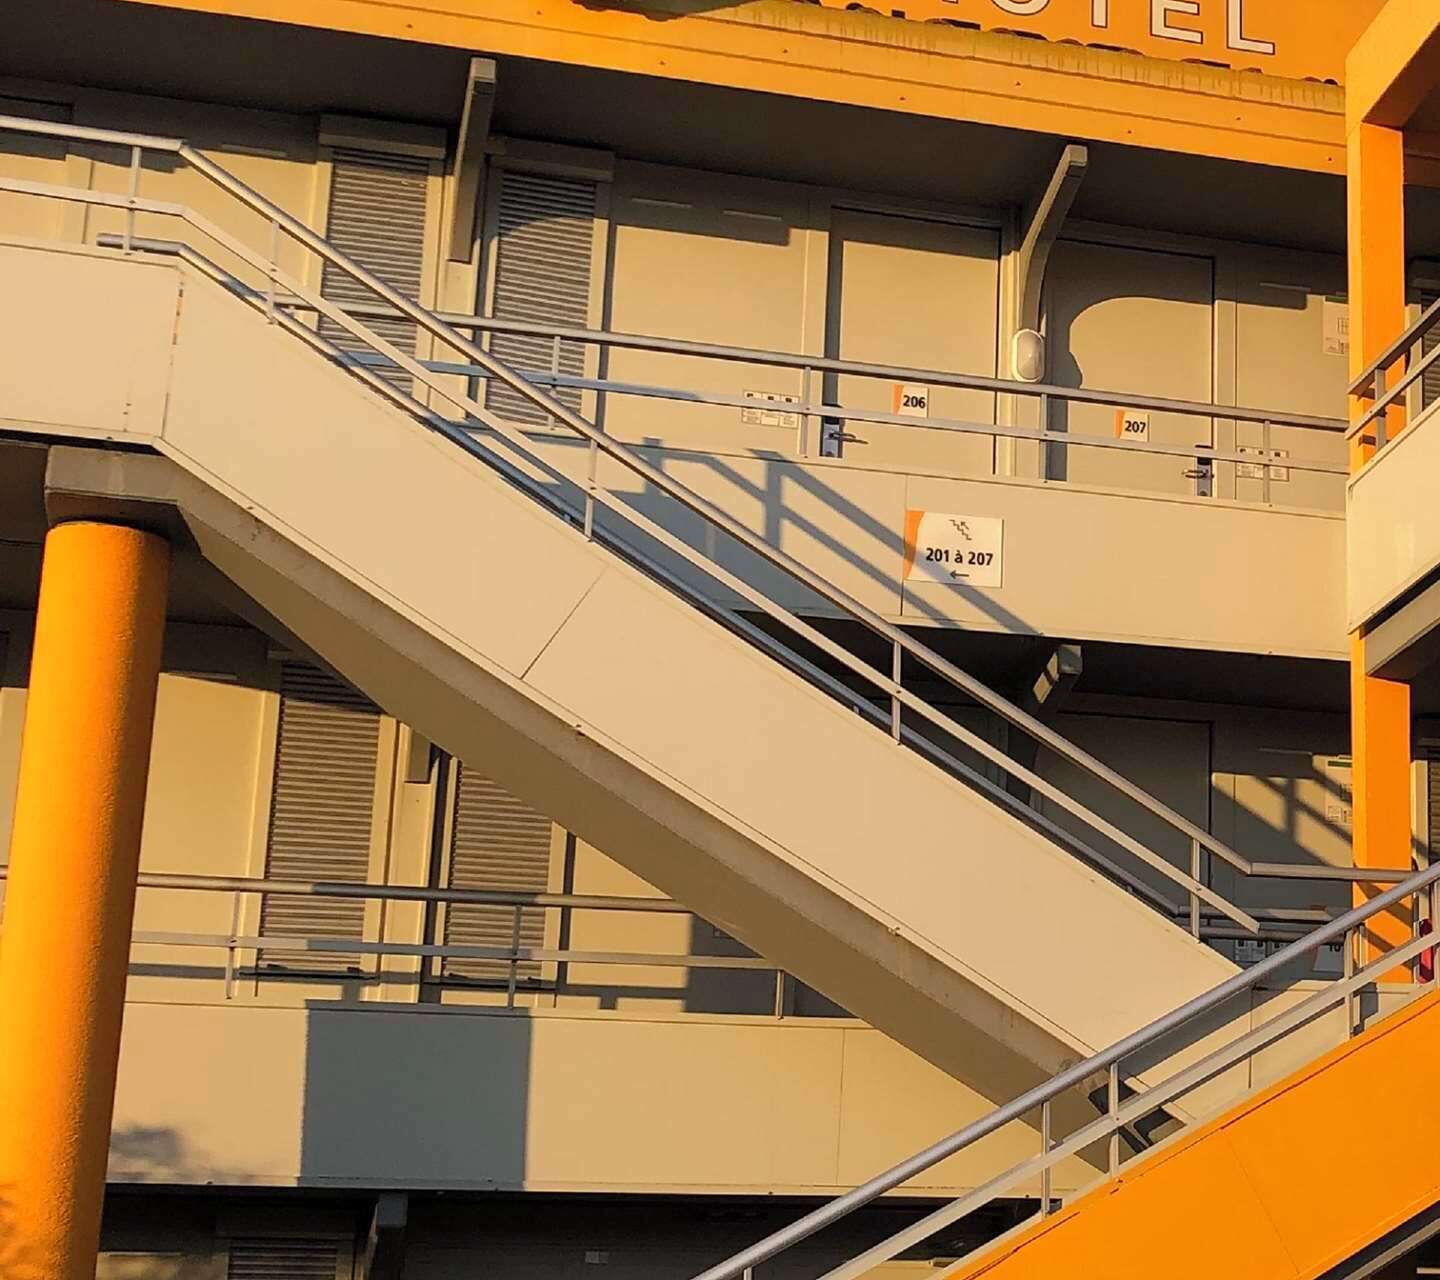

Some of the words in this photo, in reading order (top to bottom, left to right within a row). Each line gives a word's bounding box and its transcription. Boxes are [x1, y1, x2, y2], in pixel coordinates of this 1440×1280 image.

[903, 394, 926, 409] 206
[1125, 420, 1147, 433] 207
[925, 547, 950, 562] 201
[954, 550, 963, 564] à
[968, 551, 993, 566] 207
